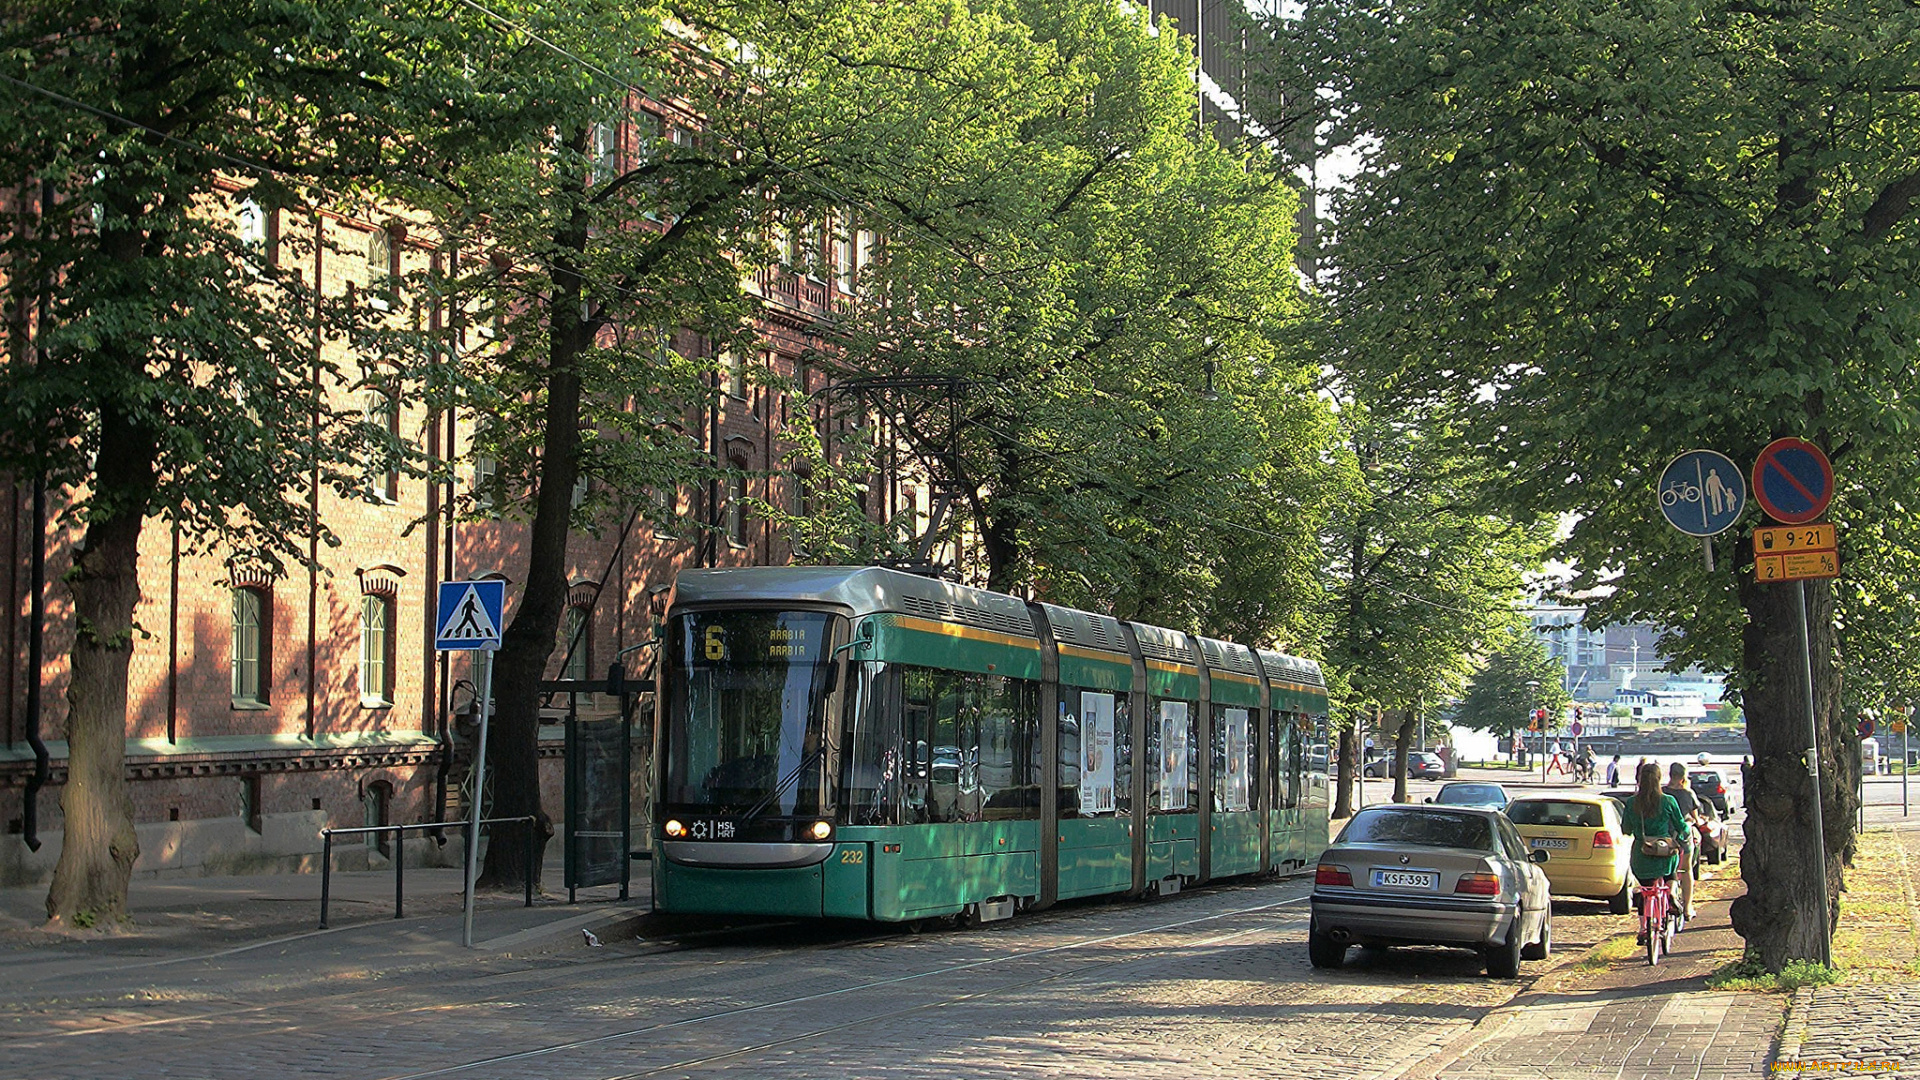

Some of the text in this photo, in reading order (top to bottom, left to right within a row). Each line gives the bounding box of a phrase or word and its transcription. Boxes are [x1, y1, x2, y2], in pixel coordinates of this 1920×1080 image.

[1766, 566, 1774, 579] 2
[770, 629, 805, 640] ARABIA
[705, 625, 724, 660] 6
[769, 645, 805, 656] ARABIA
[717, 821, 735, 829] HSL
[717, 829, 735, 838] HRT
[841, 850, 864, 864] 232
[1384, 873, 1429, 886] KSF-393
